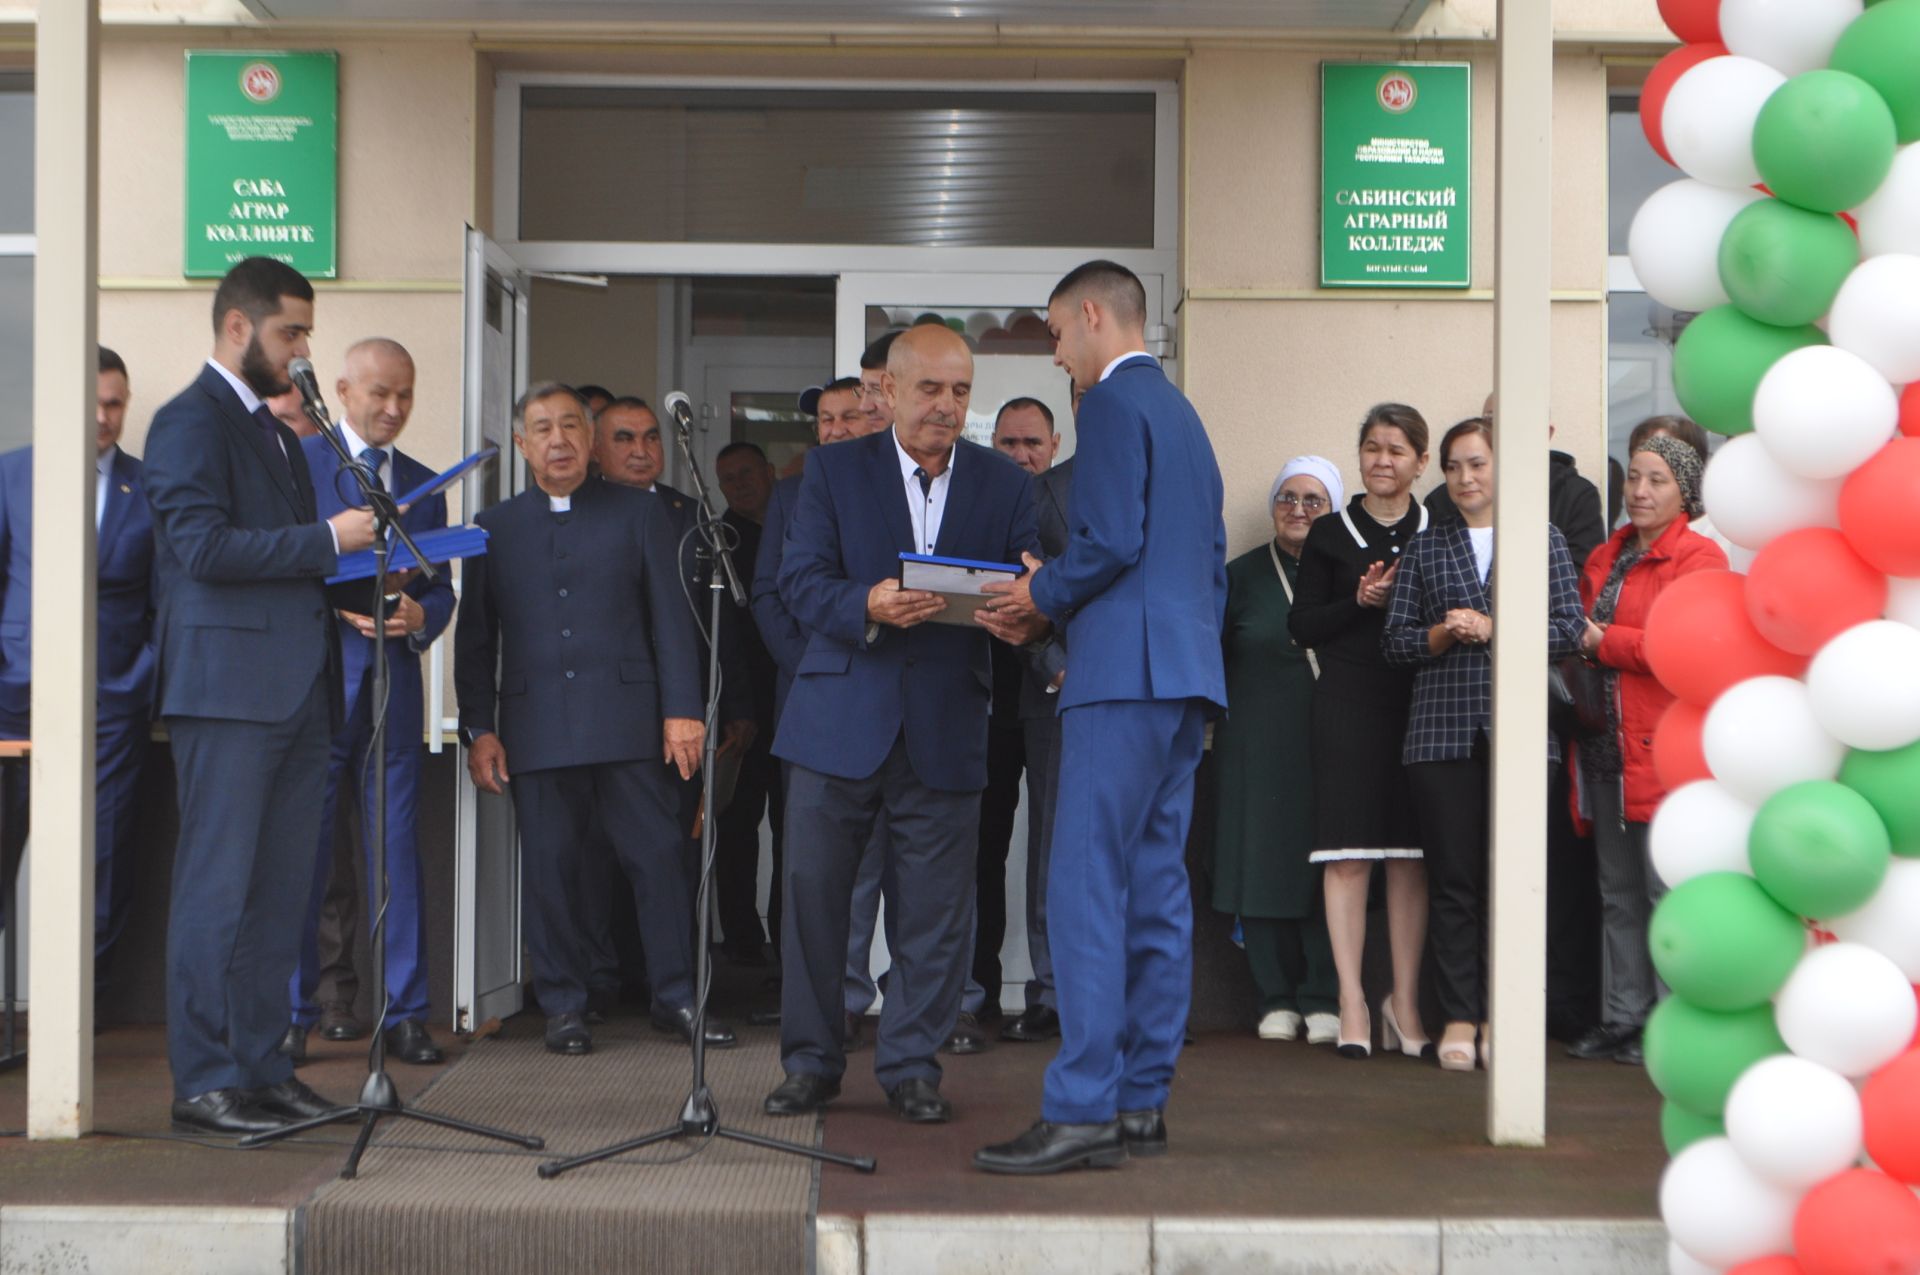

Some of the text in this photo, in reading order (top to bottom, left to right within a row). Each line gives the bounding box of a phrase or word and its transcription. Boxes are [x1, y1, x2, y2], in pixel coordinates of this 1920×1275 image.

[233, 178, 286, 197] САБА
[1335, 187, 1456, 206] САБИНСКИЙ
[229, 201, 289, 219] АГРАР
[1344, 210, 1448, 229] АГРАРНЫЙ
[1348, 235, 1445, 254] КОЛЛЕДЖ
[1366, 264, 1428, 273] БОГАТЫЕ САБЫ
